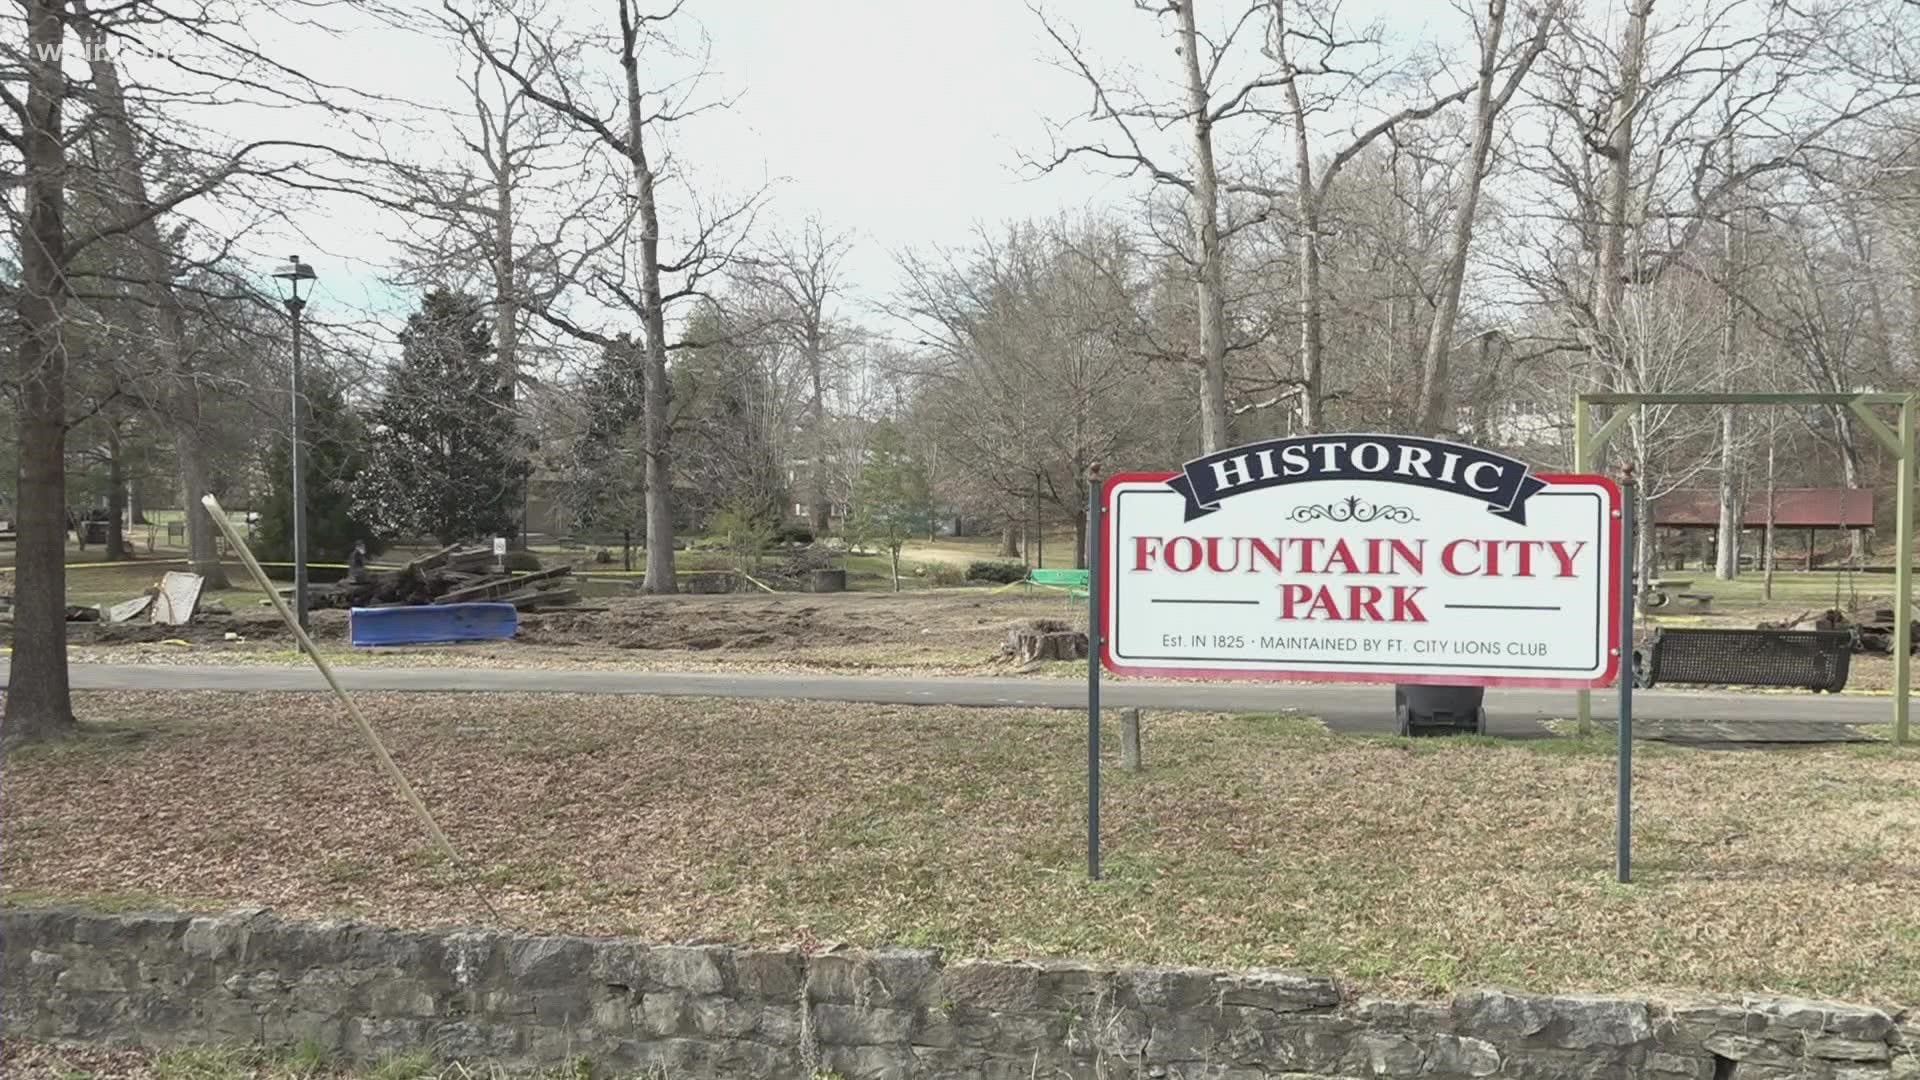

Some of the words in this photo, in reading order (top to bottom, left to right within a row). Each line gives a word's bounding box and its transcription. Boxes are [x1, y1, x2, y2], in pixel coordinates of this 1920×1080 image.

[1208, 442, 1505, 494] HISTORIC
[1131, 535, 1425, 577] FOUNTAIN
[1441, 538, 1587, 579] CITY
[1278, 583, 1429, 624] PARK
[1162, 634, 1187, 648] Est.
[1191, 635, 1207, 648] IN
[1213, 635, 1245, 649] 1825
[1260, 636, 1358, 651] MAINTAINED
[1363, 638, 1382, 652] BY
[1387, 639, 1407, 653] FT.
[1413, 640, 1449, 654] CITY
[1454, 640, 1501, 655] LIONS
[1507, 641, 1548, 657] CLUB
